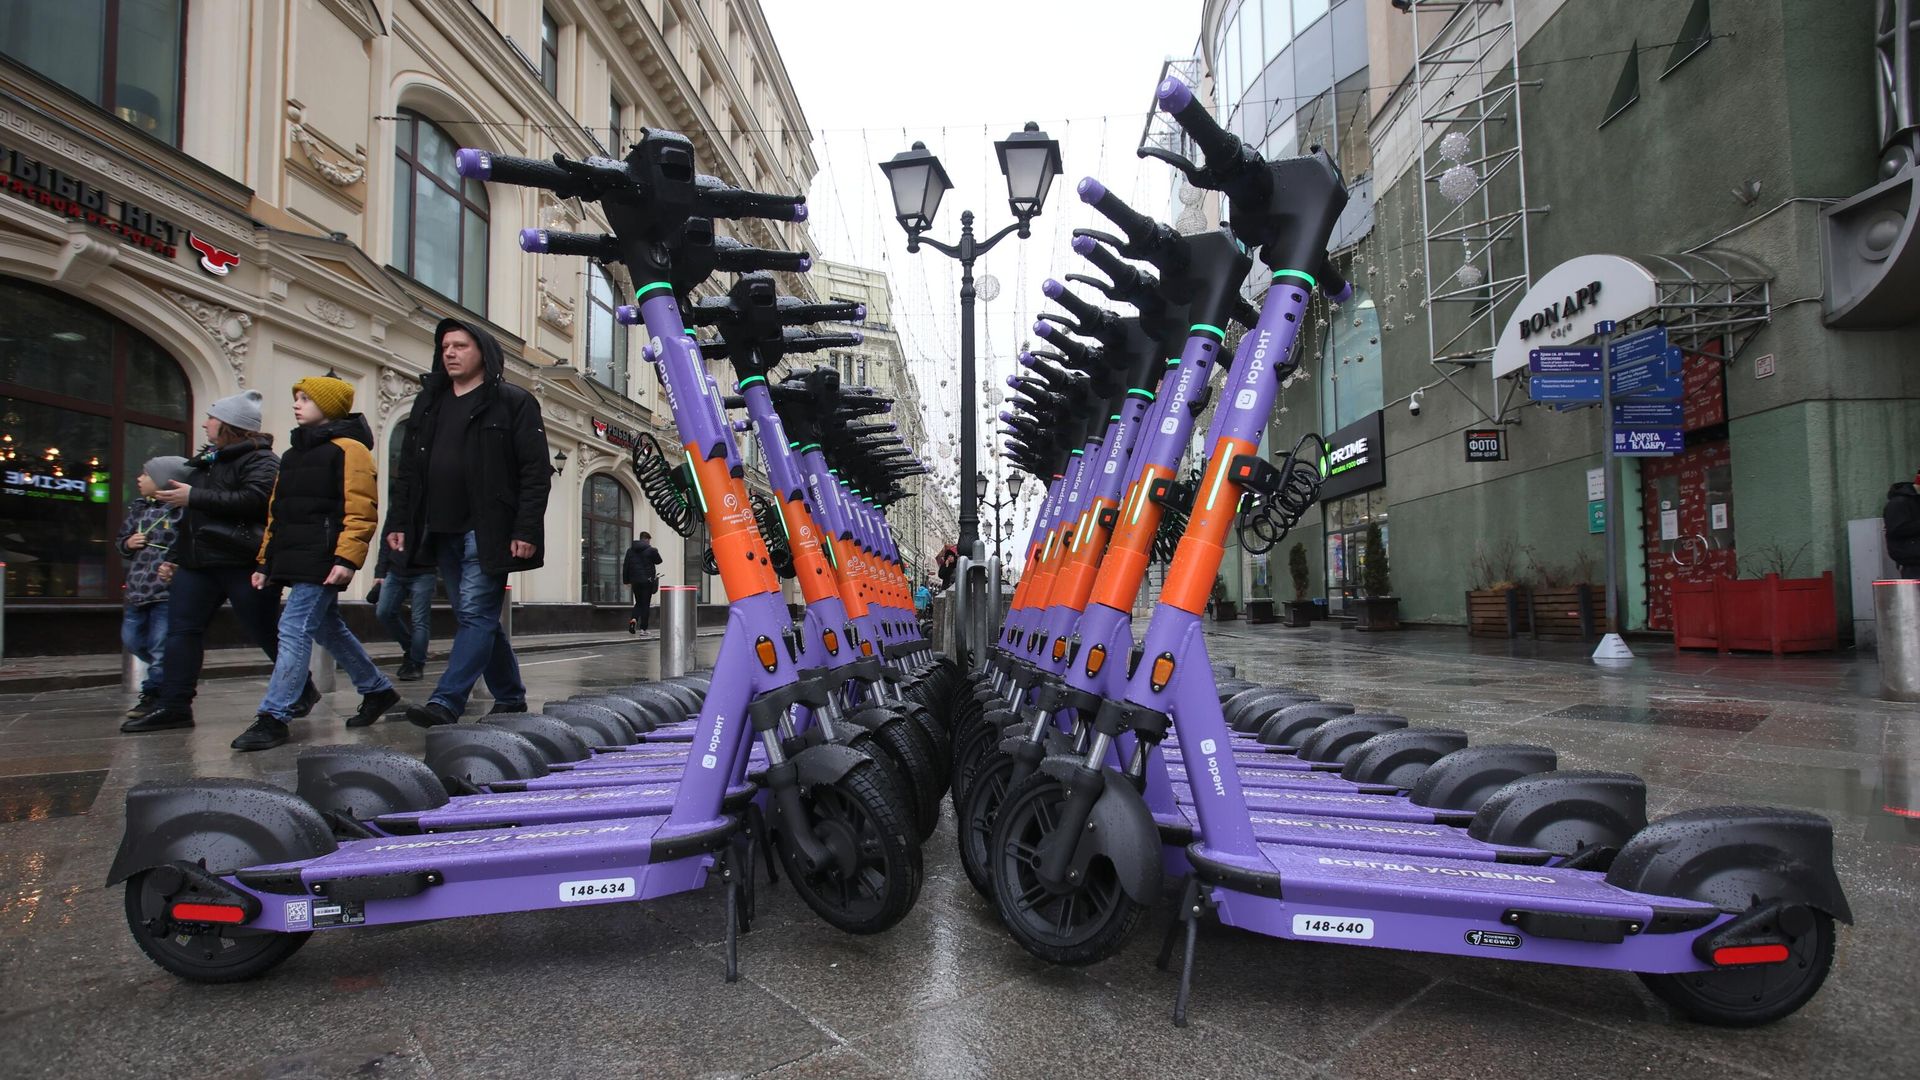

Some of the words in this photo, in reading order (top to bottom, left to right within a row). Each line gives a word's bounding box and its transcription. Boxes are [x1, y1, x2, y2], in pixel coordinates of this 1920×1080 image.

[122, 201, 181, 246] НЕТ
[1519, 302, 1560, 340] BON
[1562, 281, 1602, 319] APP
[1246, 329, 1271, 384] юрент
[1170, 367, 1192, 413] юрент
[1110, 422, 1126, 458] юрент
[1331, 437, 1368, 466] PRIME
[1469, 440, 1498, 451] ФОТО
[1073, 461, 1086, 490] юрент
[708, 714, 725, 752] юрент
[1207, 756, 1226, 797] юрент
[1250, 816, 1313, 828] СТОЮ
[1339, 824, 1441, 837] ПРОБКАХ
[1318, 857, 1418, 872] ВСЕГДА
[1423, 866, 1556, 884] УСПЕВАЮ
[570, 882, 626, 897] 148-634
[1304, 920, 1364, 934] 148-640
[1483, 938, 1516, 946] SEGWAY
